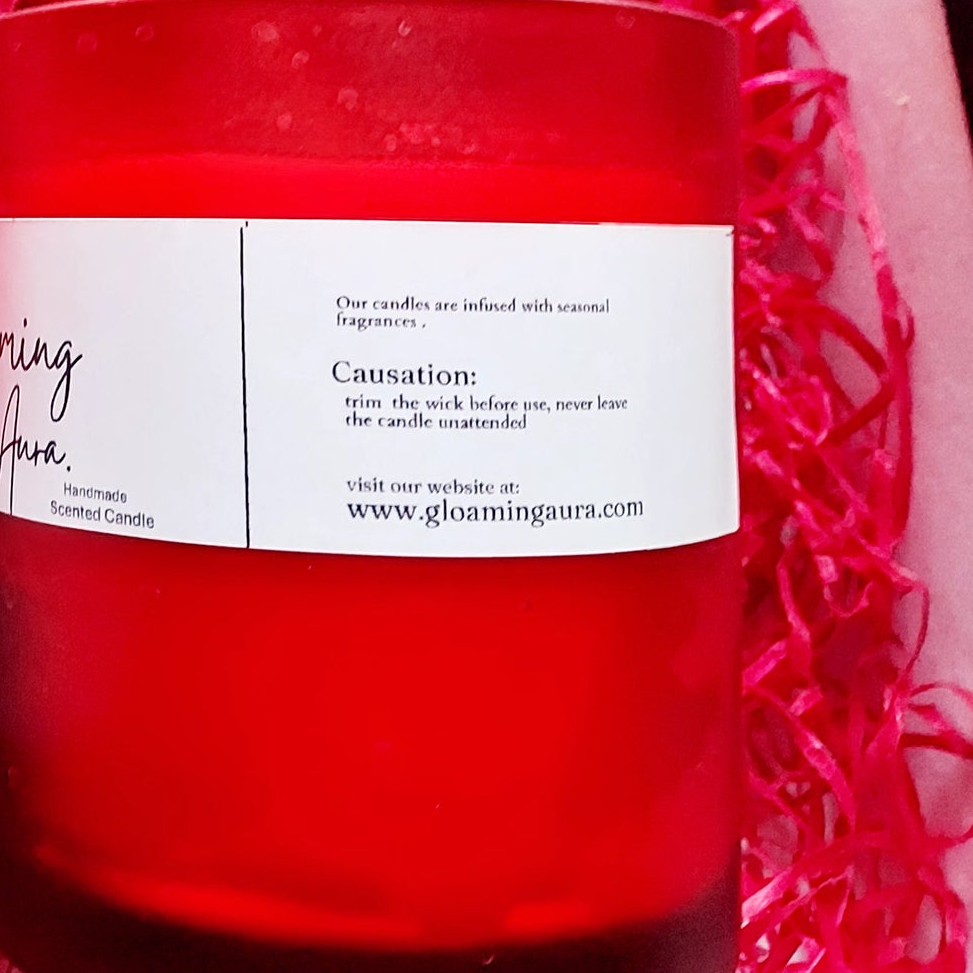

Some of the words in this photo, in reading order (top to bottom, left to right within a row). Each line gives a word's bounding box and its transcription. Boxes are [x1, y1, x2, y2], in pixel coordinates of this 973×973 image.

[337, 295, 368, 310] Our
[373, 297, 430, 311] candles
[435, 300, 458, 312] are
[463, 297, 516, 313] infused
[522, 298, 553, 313] with
[557, 299, 610, 314] seasonal
[337, 313, 417, 331] fragrances
[332, 360, 477, 386] Causation:
[345, 393, 381, 409] trim
[392, 394, 419, 410] the
[426, 395, 464, 411] wick
[470, 394, 518, 411] before
[524, 400, 551, 414] use,
[556, 399, 593, 411] never
[597, 395, 628, 410] leave
[345, 411, 372, 427] the
[378, 413, 432, 428] candle
[439, 414, 527, 429] unattended
[63, 482, 127, 504] Handmade
[347, 477, 384, 493] visit
[390, 481, 422, 494] our
[427, 479, 494, 494] website
[499, 481, 520, 494] at:
[50, 500, 101, 522] Scented
[104, 509, 155, 529] Candle
[347, 498, 644, 528] www.gloamingaura.com
